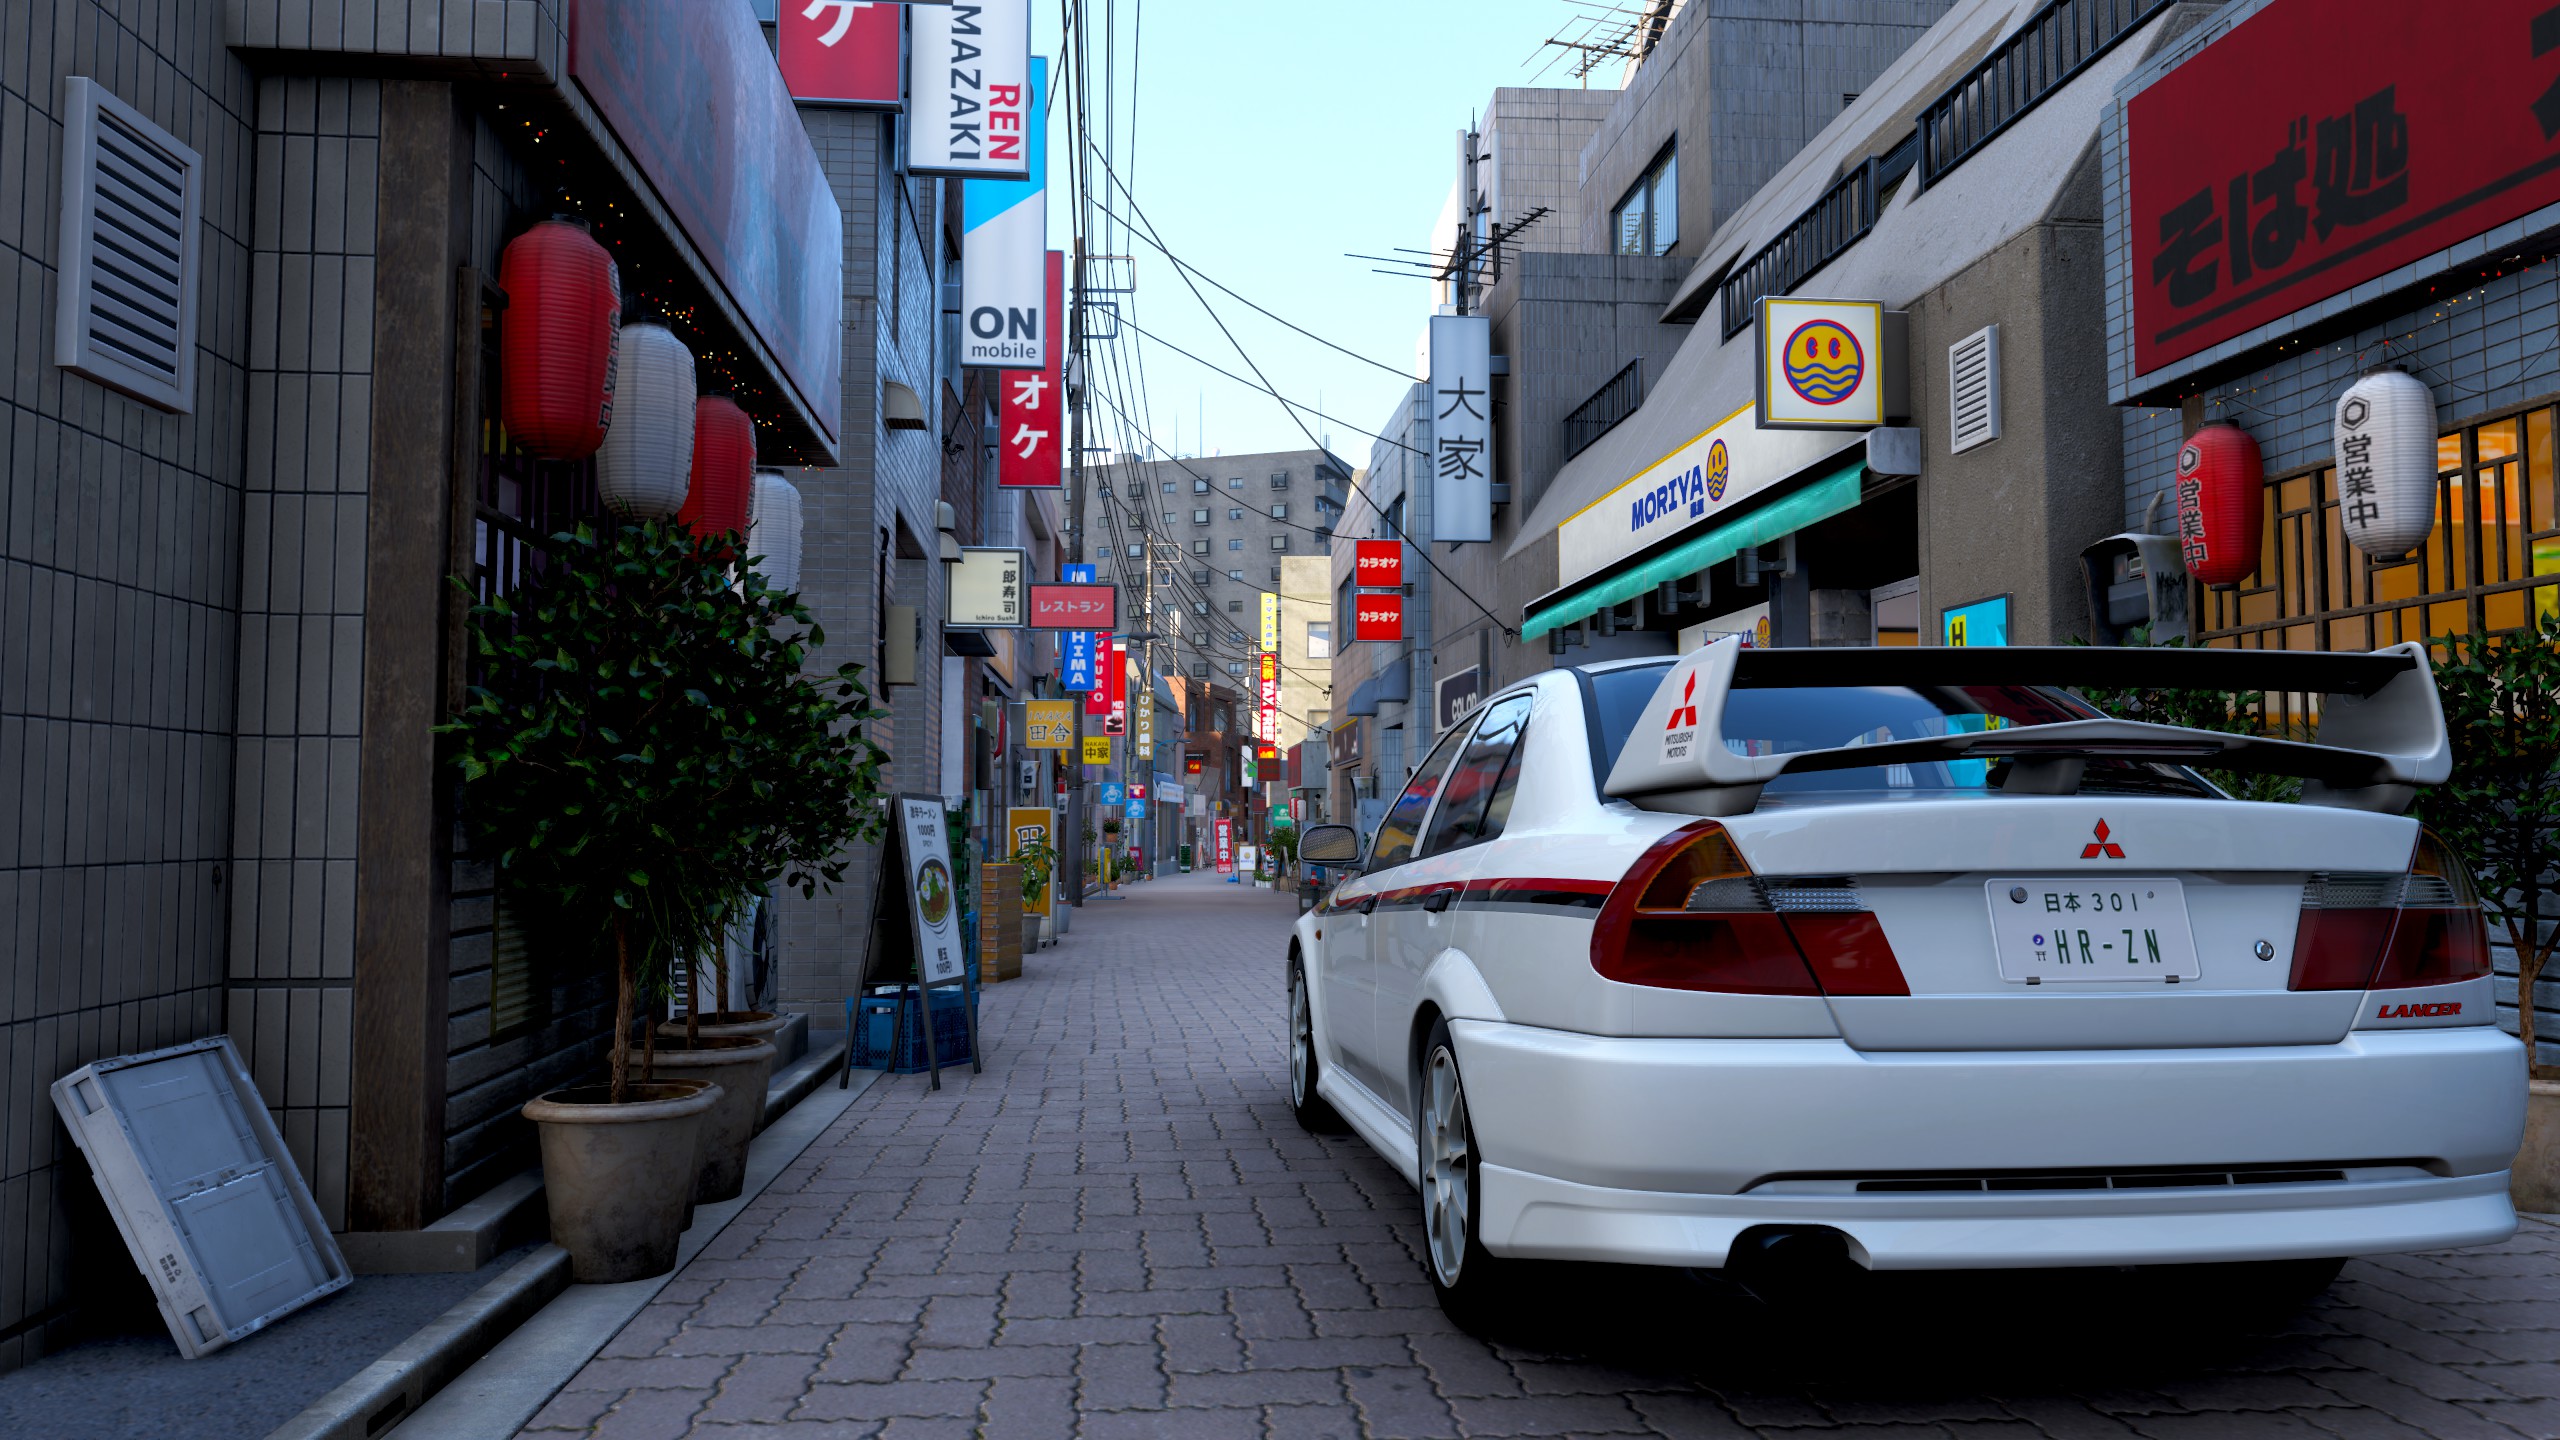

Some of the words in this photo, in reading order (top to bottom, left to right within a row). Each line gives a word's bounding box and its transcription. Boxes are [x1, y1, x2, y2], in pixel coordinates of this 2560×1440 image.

[950, 5, 982, 162] MAZAKI
[988, 83, 1020, 160] REN
[2152, 83, 2409, 309] そば処
[970, 306, 1037, 340] ON
[972, 343, 1036, 358] mobile
[1011, 374, 1048, 459] オケ
[1438, 376, 1485, 480] 大家
[2343, 433, 2379, 529] 営業中
[1632, 464, 1704, 532] MORIYA
[2179, 478, 2208, 570] 営業中
[1359, 557, 1399, 569] カラオケ
[1002, 560, 1017, 615] 一郎寿司
[1039, 601, 1105, 613] レストラン
[1359, 611, 1399, 623] カラオケ
[1262, 680, 1275, 706] TAX
[1028, 710, 1072, 720] INAKA
[1262, 709, 1275, 742] FREE
[1029, 723, 1071, 742] 田舎
[1665, 731, 1693, 745] MITSUBISHI
[1085, 747, 1109, 758] 中家
[1666, 746, 1687, 758] MOTORS
[2044, 892, 2081, 913] 日本
[2092, 892, 2138, 912] 301
[2054, 929, 2161, 964] HR-ZN
[2376, 1002, 2462, 1018] LANCER
